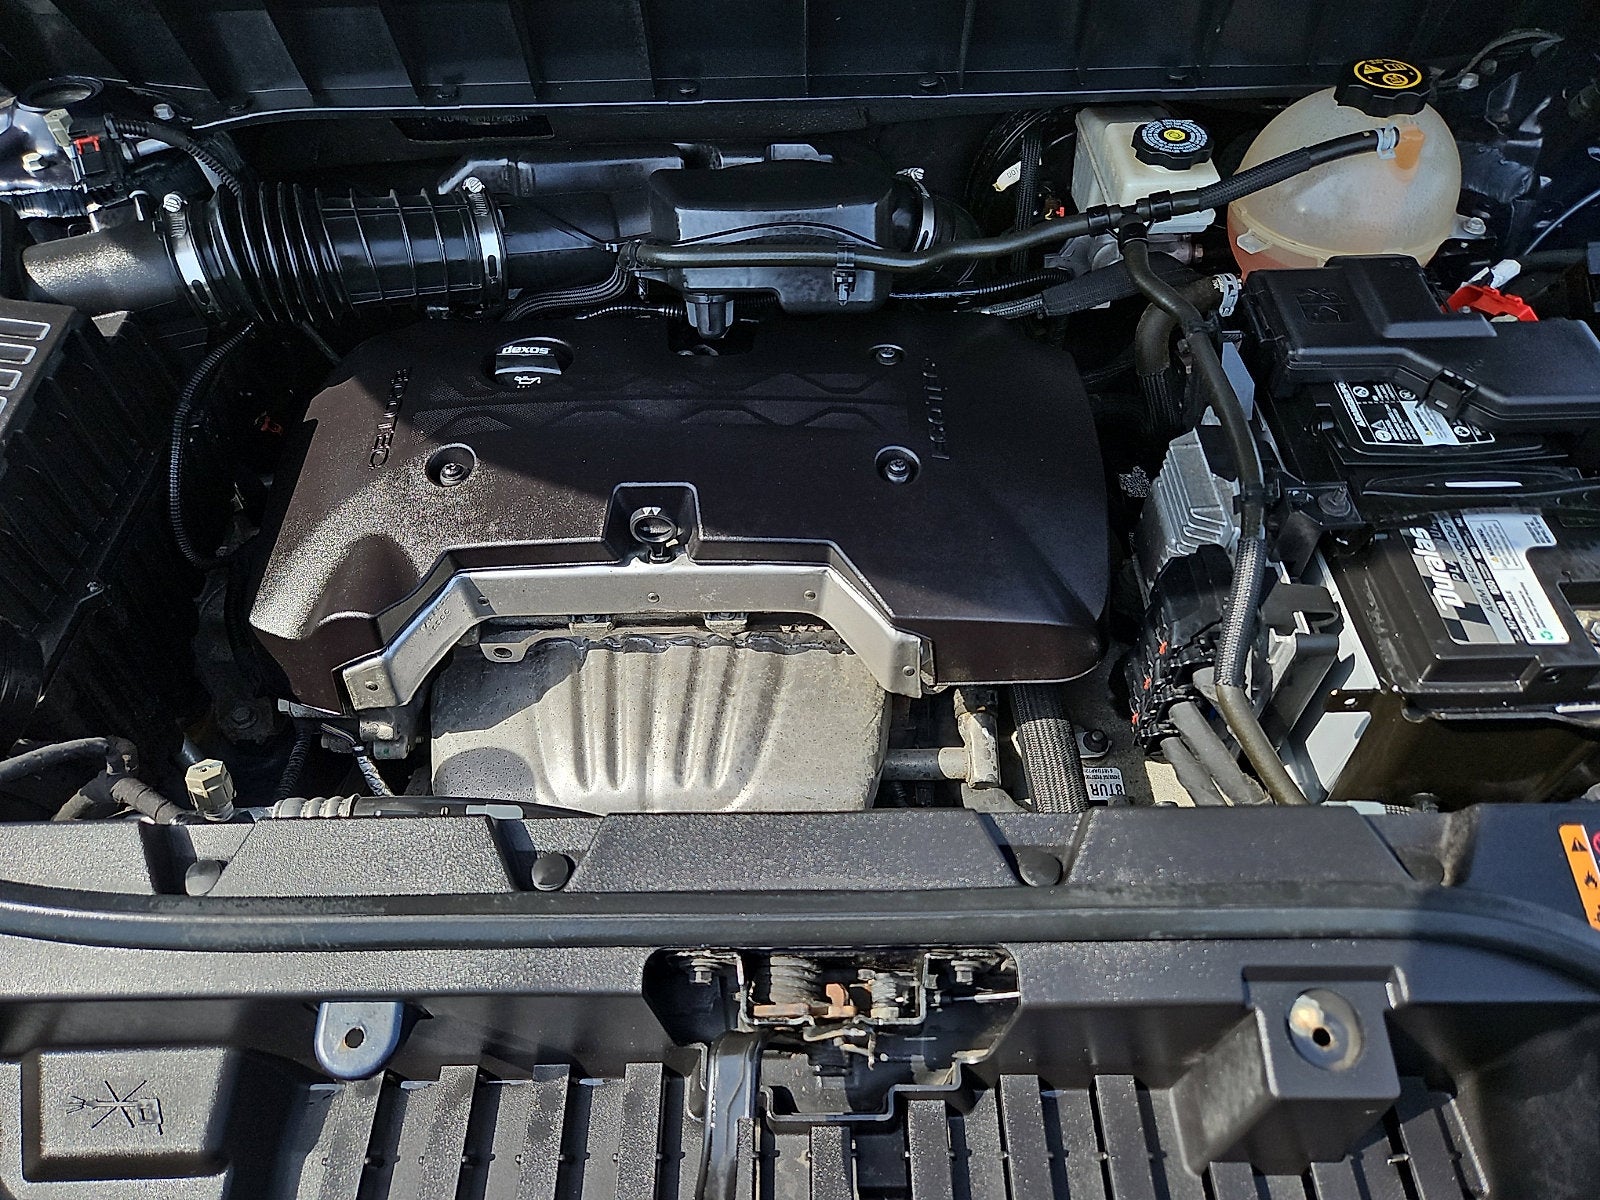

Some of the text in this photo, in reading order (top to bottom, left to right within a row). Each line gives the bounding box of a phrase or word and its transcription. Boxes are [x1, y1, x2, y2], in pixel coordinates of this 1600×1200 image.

[501, 345, 551, 354] dexos
[1442, 517, 1480, 584] TECHNOLOGY
[1409, 527, 1467, 612] Duralas
[1477, 589, 1496, 614] AGM
[1089, 783, 1124, 797] 8TUR
